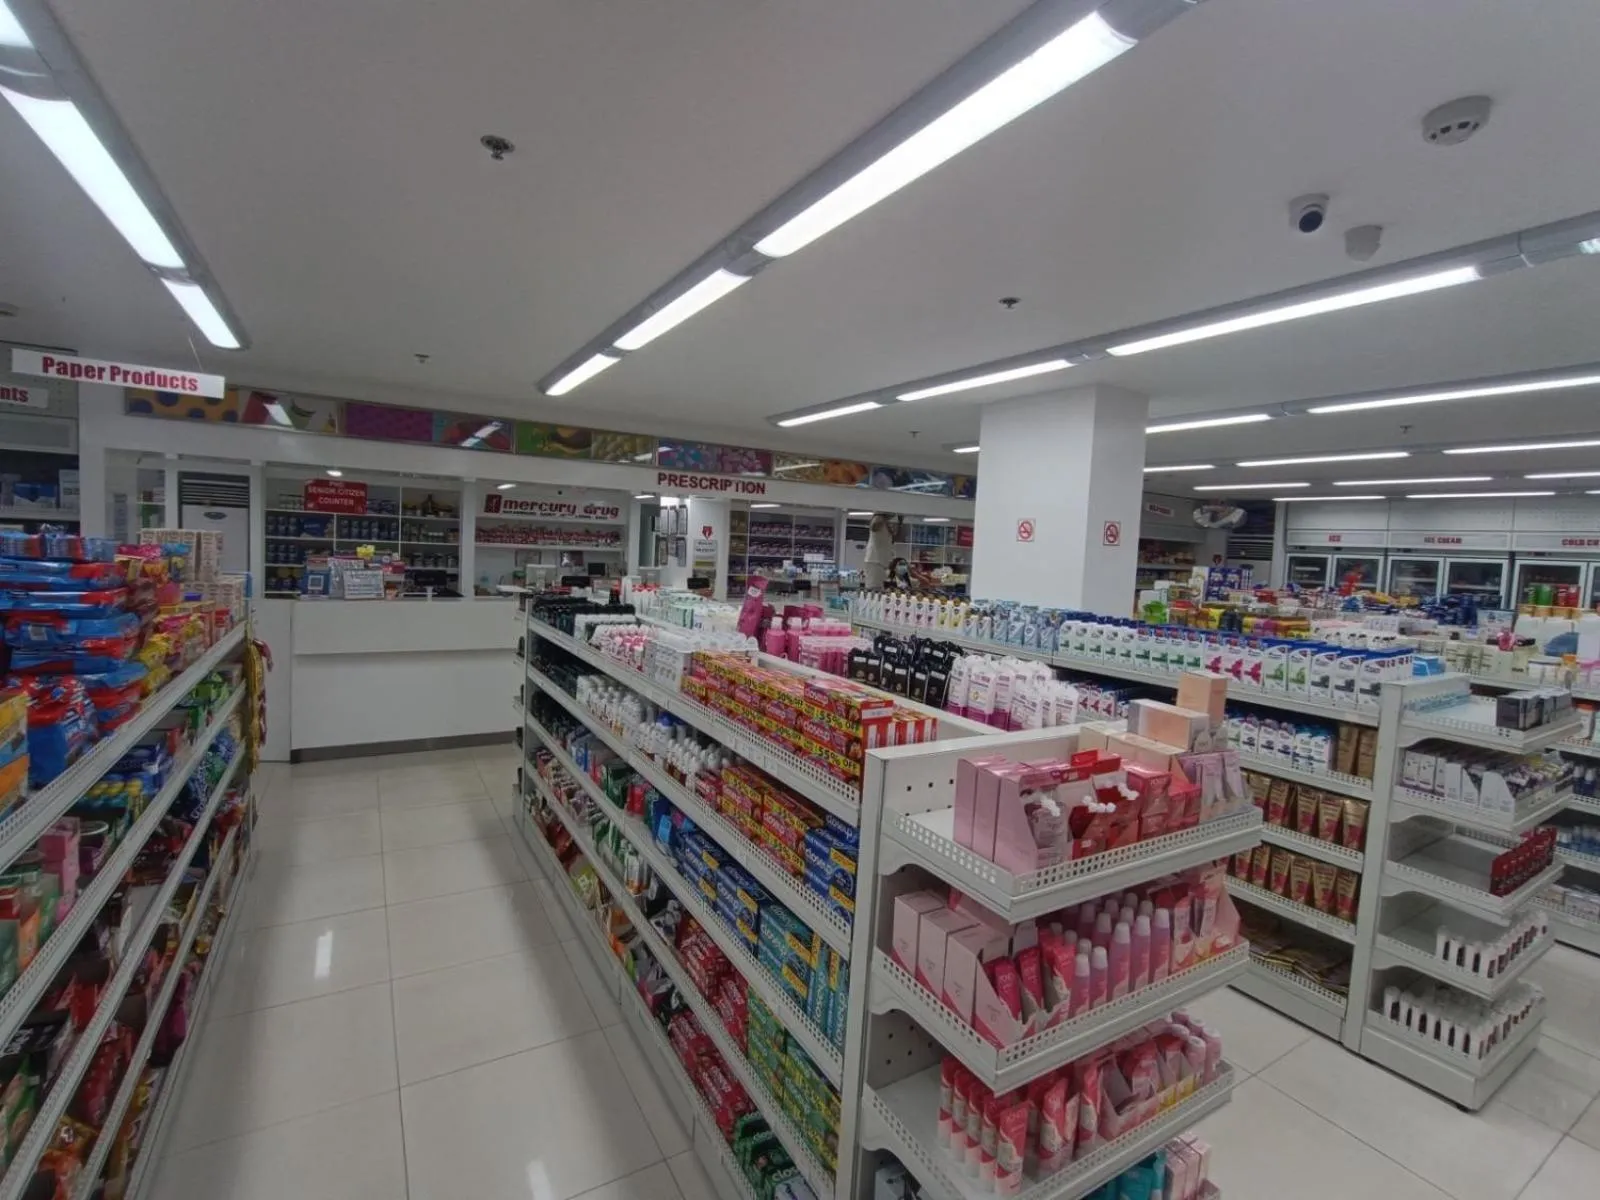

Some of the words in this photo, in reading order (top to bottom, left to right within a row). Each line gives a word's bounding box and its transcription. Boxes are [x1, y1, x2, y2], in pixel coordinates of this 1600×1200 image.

[42, 356, 106, 380] Paper
[109, 365, 198, 392] Products
[657, 472, 765, 495] PRESCRIPTION
[503, 499, 577, 515] mercury
[583, 503, 619, 518] drug
